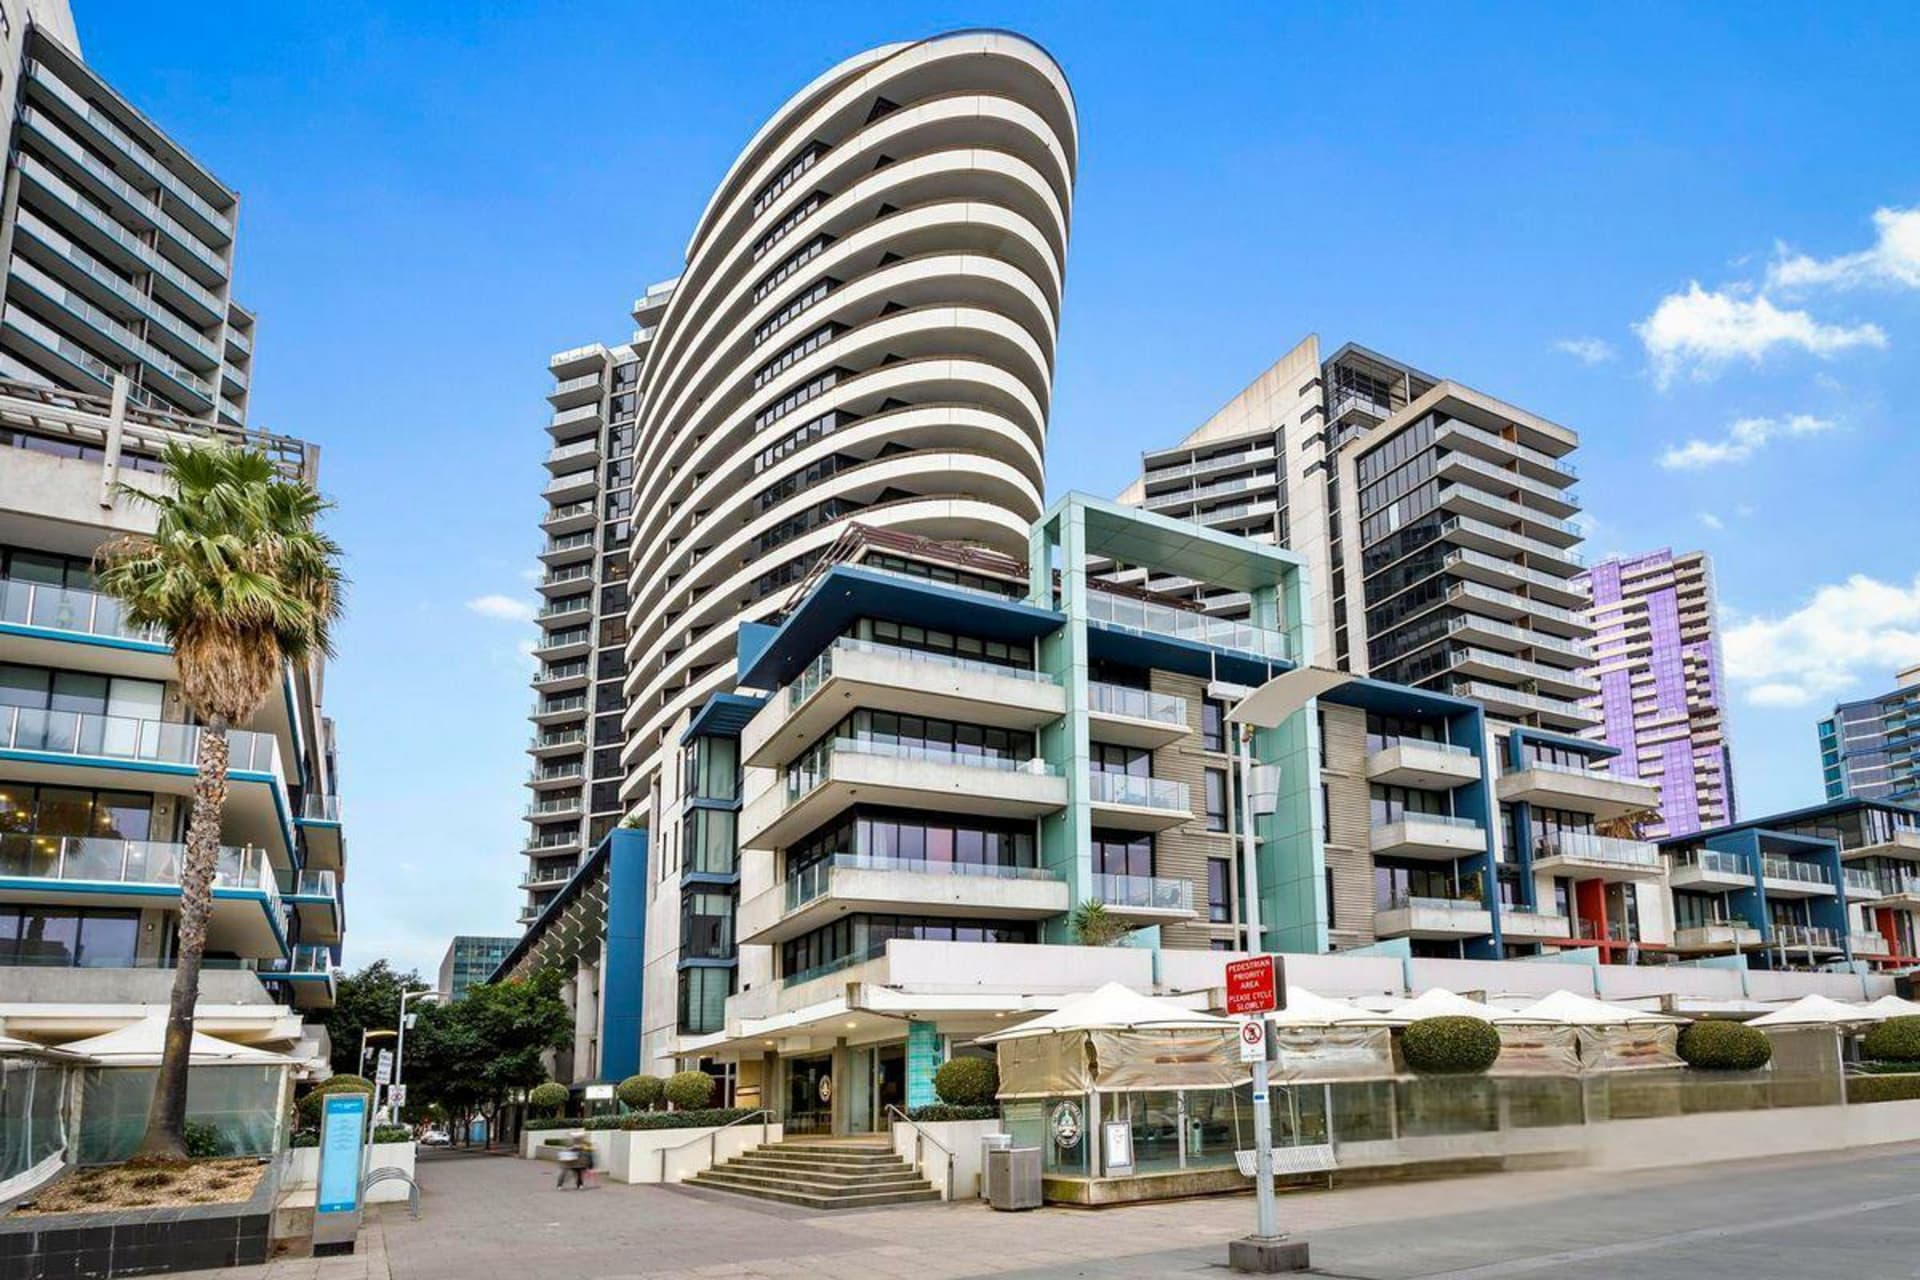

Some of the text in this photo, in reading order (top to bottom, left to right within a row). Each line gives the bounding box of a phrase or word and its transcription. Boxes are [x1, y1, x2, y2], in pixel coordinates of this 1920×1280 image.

[1228, 959, 1271, 972] PEDESTRIAN
[1233, 969, 1265, 981] PRIORITY
[1240, 980, 1259, 989] AREA
[1229, 990, 1272, 1003] PLEASE CYCLE
[1236, 1001, 1264, 1011] SLOWLY
